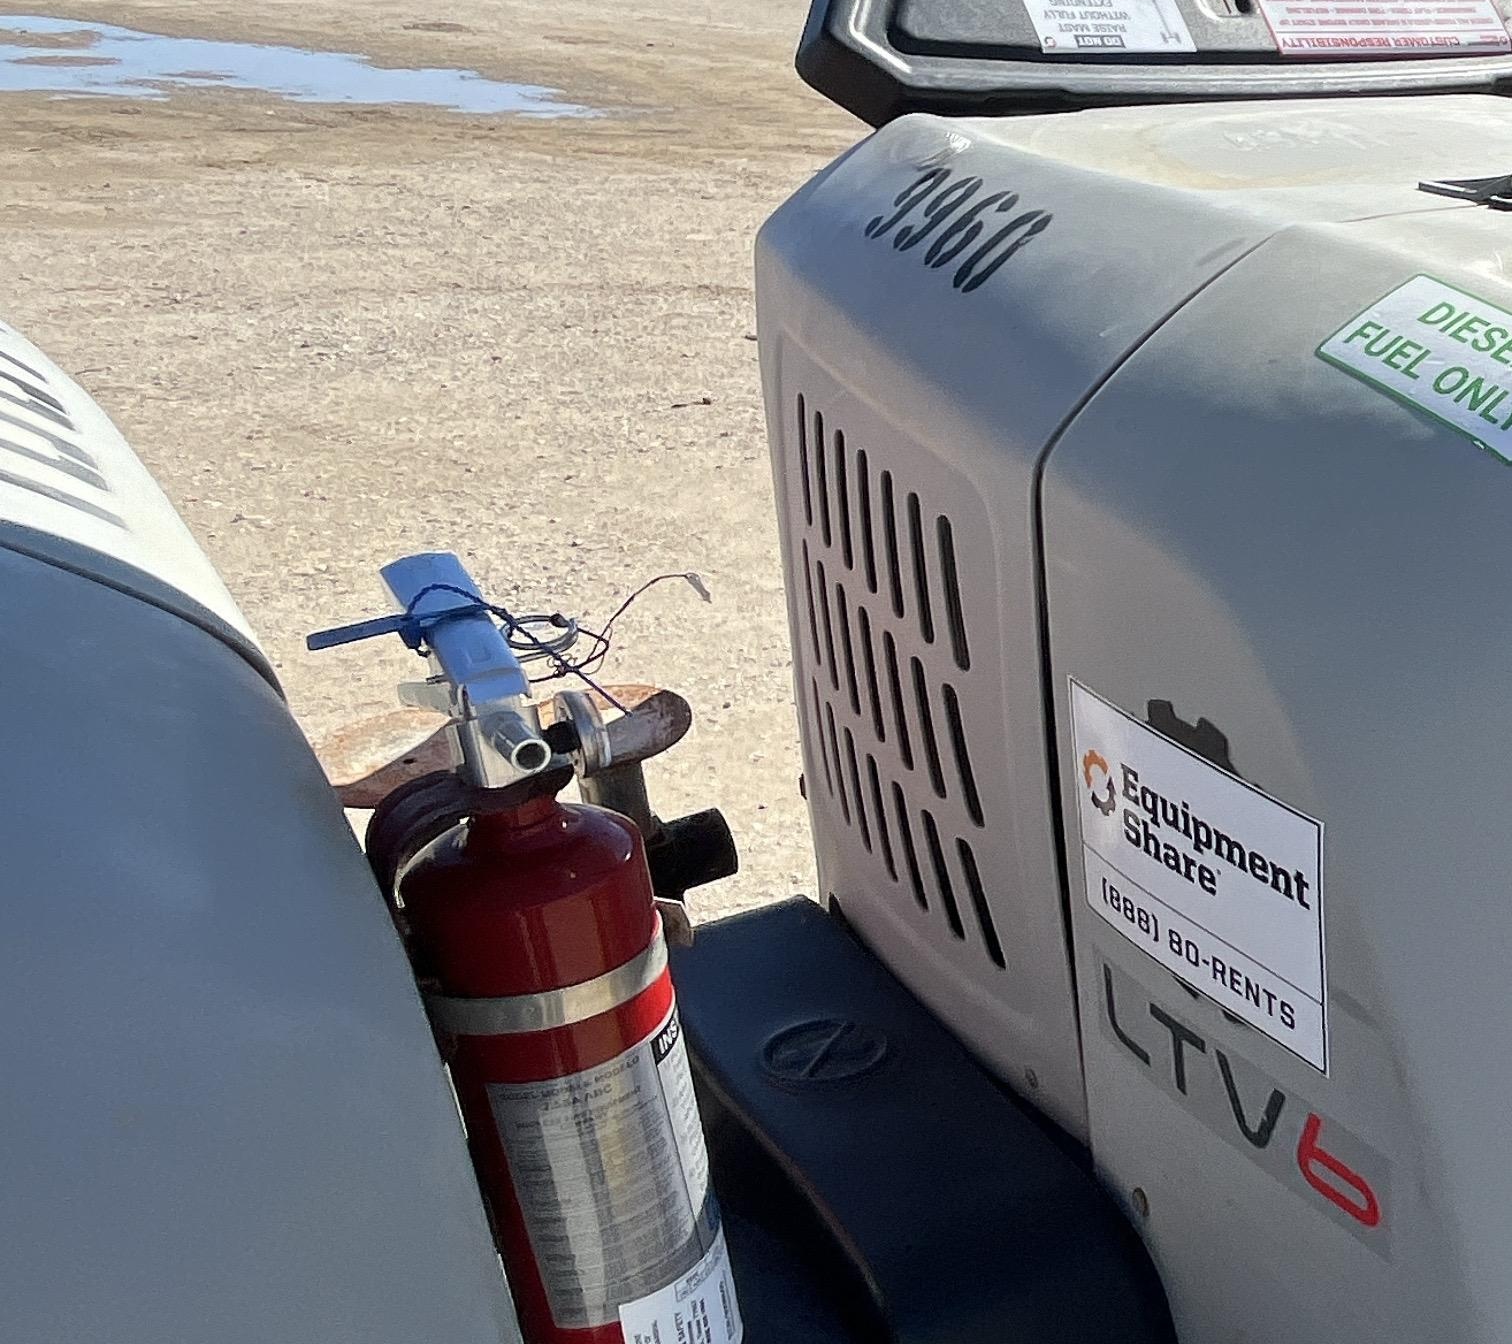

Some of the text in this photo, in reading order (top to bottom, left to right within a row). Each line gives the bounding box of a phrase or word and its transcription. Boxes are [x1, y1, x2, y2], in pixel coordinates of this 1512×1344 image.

[1281, 36, 1392, 49] RESPONSIBILITY
[1392, 36, 1460, 48] CUSTOMER
[864, 167, 1053, 293] 9960
[1342, 320, 1432, 380] FUEL
[1119, 762, 1312, 910] Equipment
[1122, 809, 1220, 897] Share
[1101, 876, 1297, 1031] (888) 80-RENTS
